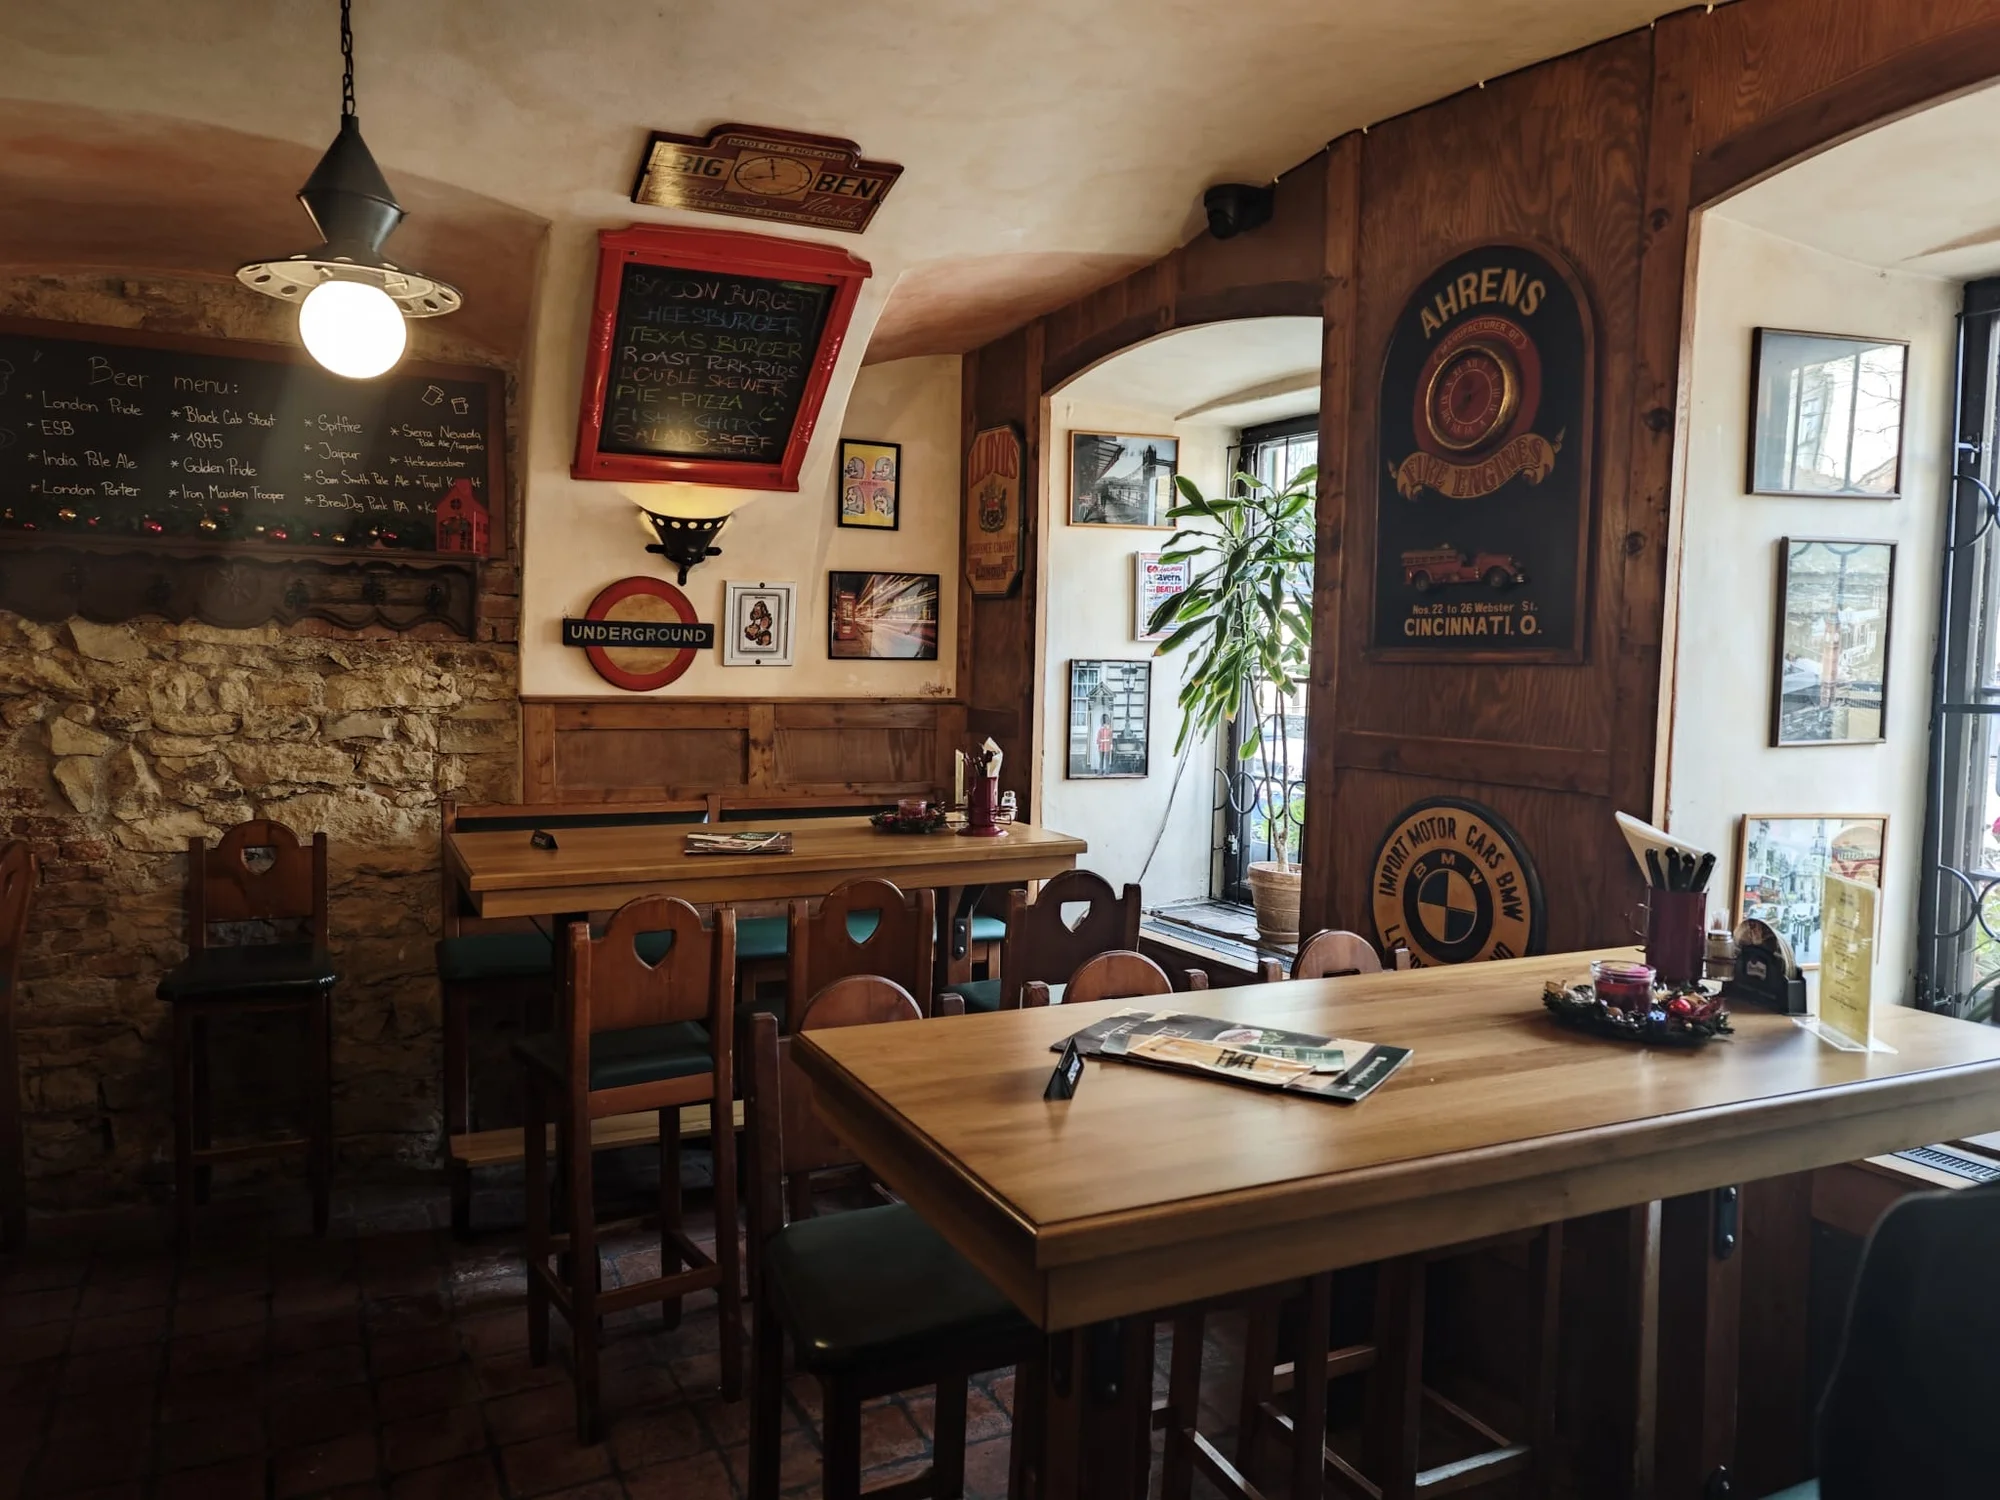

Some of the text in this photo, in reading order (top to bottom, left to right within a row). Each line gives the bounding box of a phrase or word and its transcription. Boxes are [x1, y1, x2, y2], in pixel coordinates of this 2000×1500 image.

[785, 145, 845, 161] ENGLAND
[677, 155, 724, 177] BIG
[814, 172, 877, 199] BEN
[1419, 267, 1547, 340] AHRENS
[637, 305, 803, 338] HEESBURGER
[629, 325, 803, 361] TEXAS BURGER
[623, 346, 700, 366] ROAST
[88, 356, 239, 395] Beer menu:
[619, 366, 788, 397] DOUBLE SKEWER
[42, 390, 143, 416] London Pride
[615, 384, 661, 403] PIE
[680, 392, 743, 411] PIZZA
[40, 419, 75, 436] ESB
[182, 405, 277, 428] Black Cab Stout
[318, 413, 362, 437] Spitfire
[694, 412, 762, 437] CHIPS
[186, 431, 223, 449] 1845
[402, 423, 482, 441] Sierra Nevada
[43, 450, 138, 470] India Pale Ale
[318, 442, 361, 465] Jaipur
[183, 456, 258, 477] Golden Pride
[1402, 436, 1543, 497] FIRE ENGINES
[42, 479, 141, 497] London Porter
[315, 469, 340, 486] Sam
[371, 472, 390, 486] Pale
[394, 474, 410, 487] Ale
[182, 484, 204, 500] Iron
[208, 484, 248, 500] Maiden
[316, 494, 364, 514] BrewDog
[365, 495, 388, 511] Punk
[393, 499, 409, 512] IPA
[1413, 601, 1538, 614] Nos. 22 to 26 Webster St.
[571, 625, 707, 643] UNDERGROUND
[1379, 817, 1524, 922] IMPORT MOTOR CARS BMW
